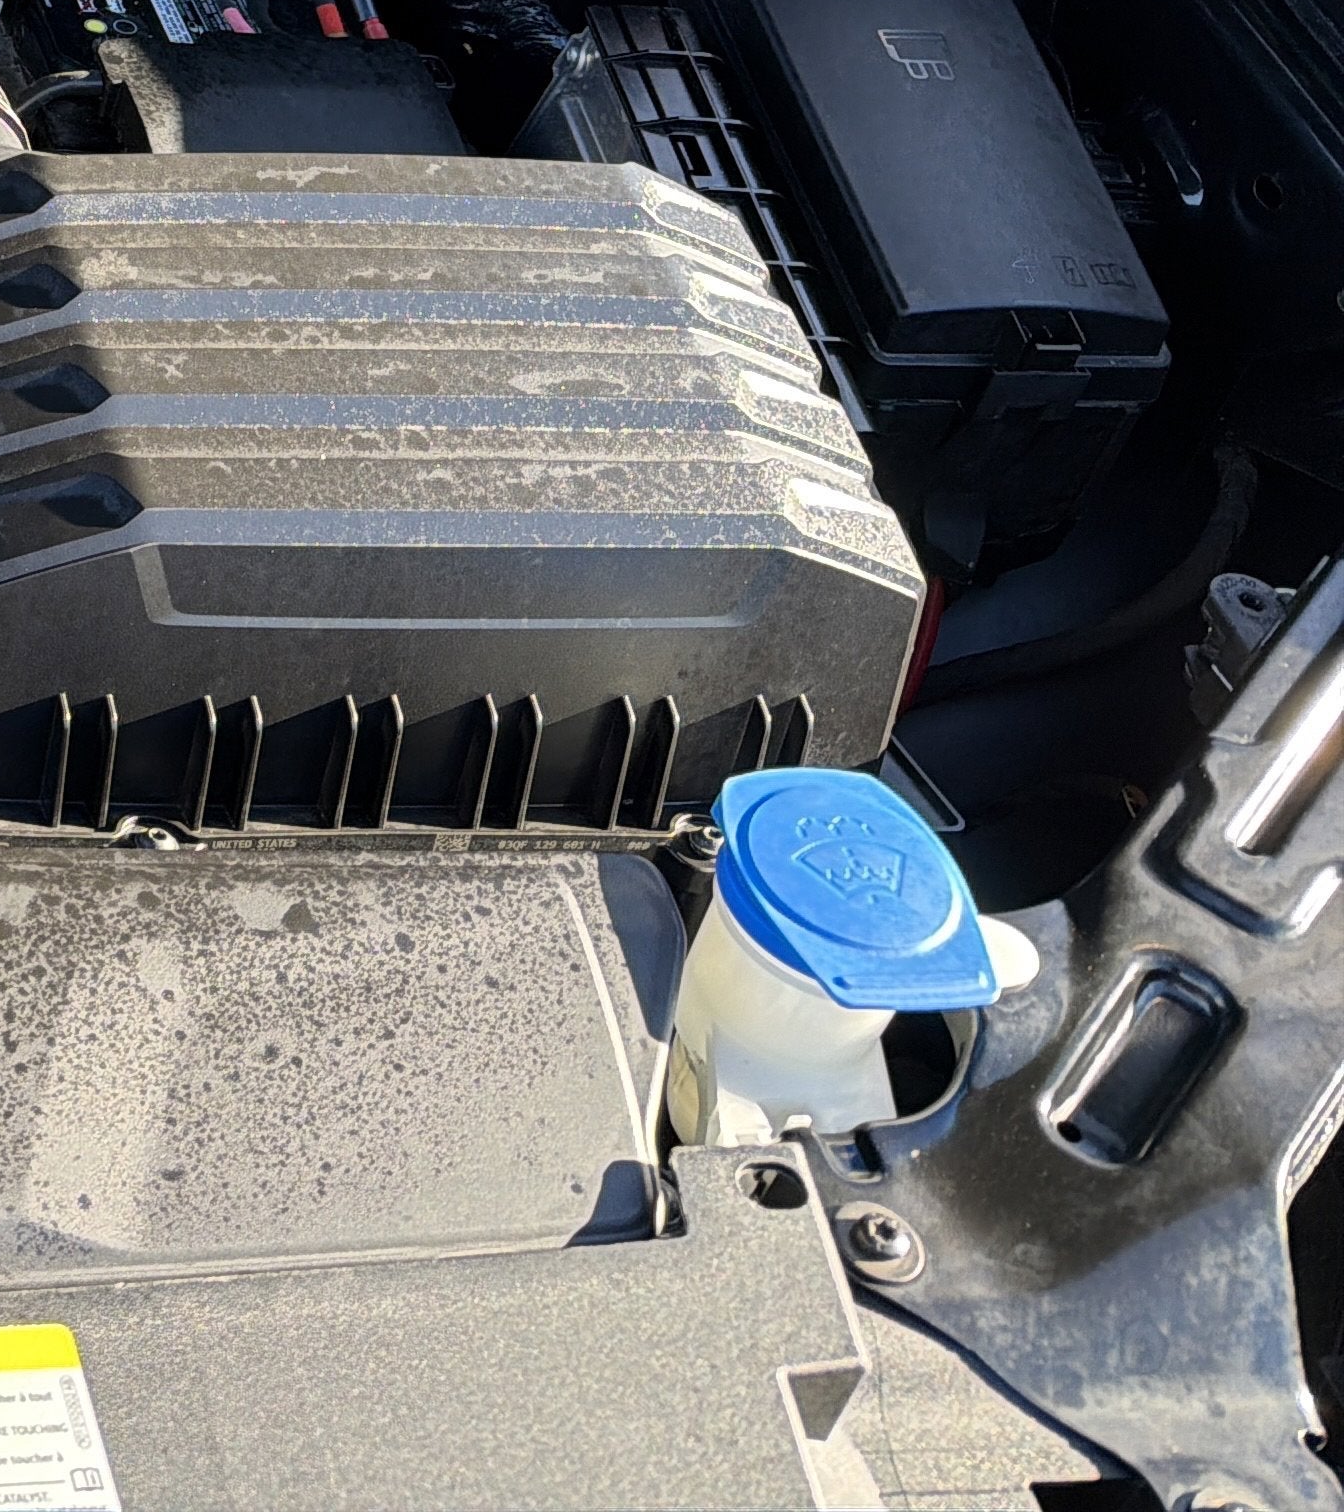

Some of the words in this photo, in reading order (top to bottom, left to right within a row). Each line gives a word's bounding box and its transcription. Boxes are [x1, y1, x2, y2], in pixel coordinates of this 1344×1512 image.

[212, 839, 251, 850] UNITED
[256, 838, 297, 849] STATES
[11, 1423, 68, 1436] TOUCHING
